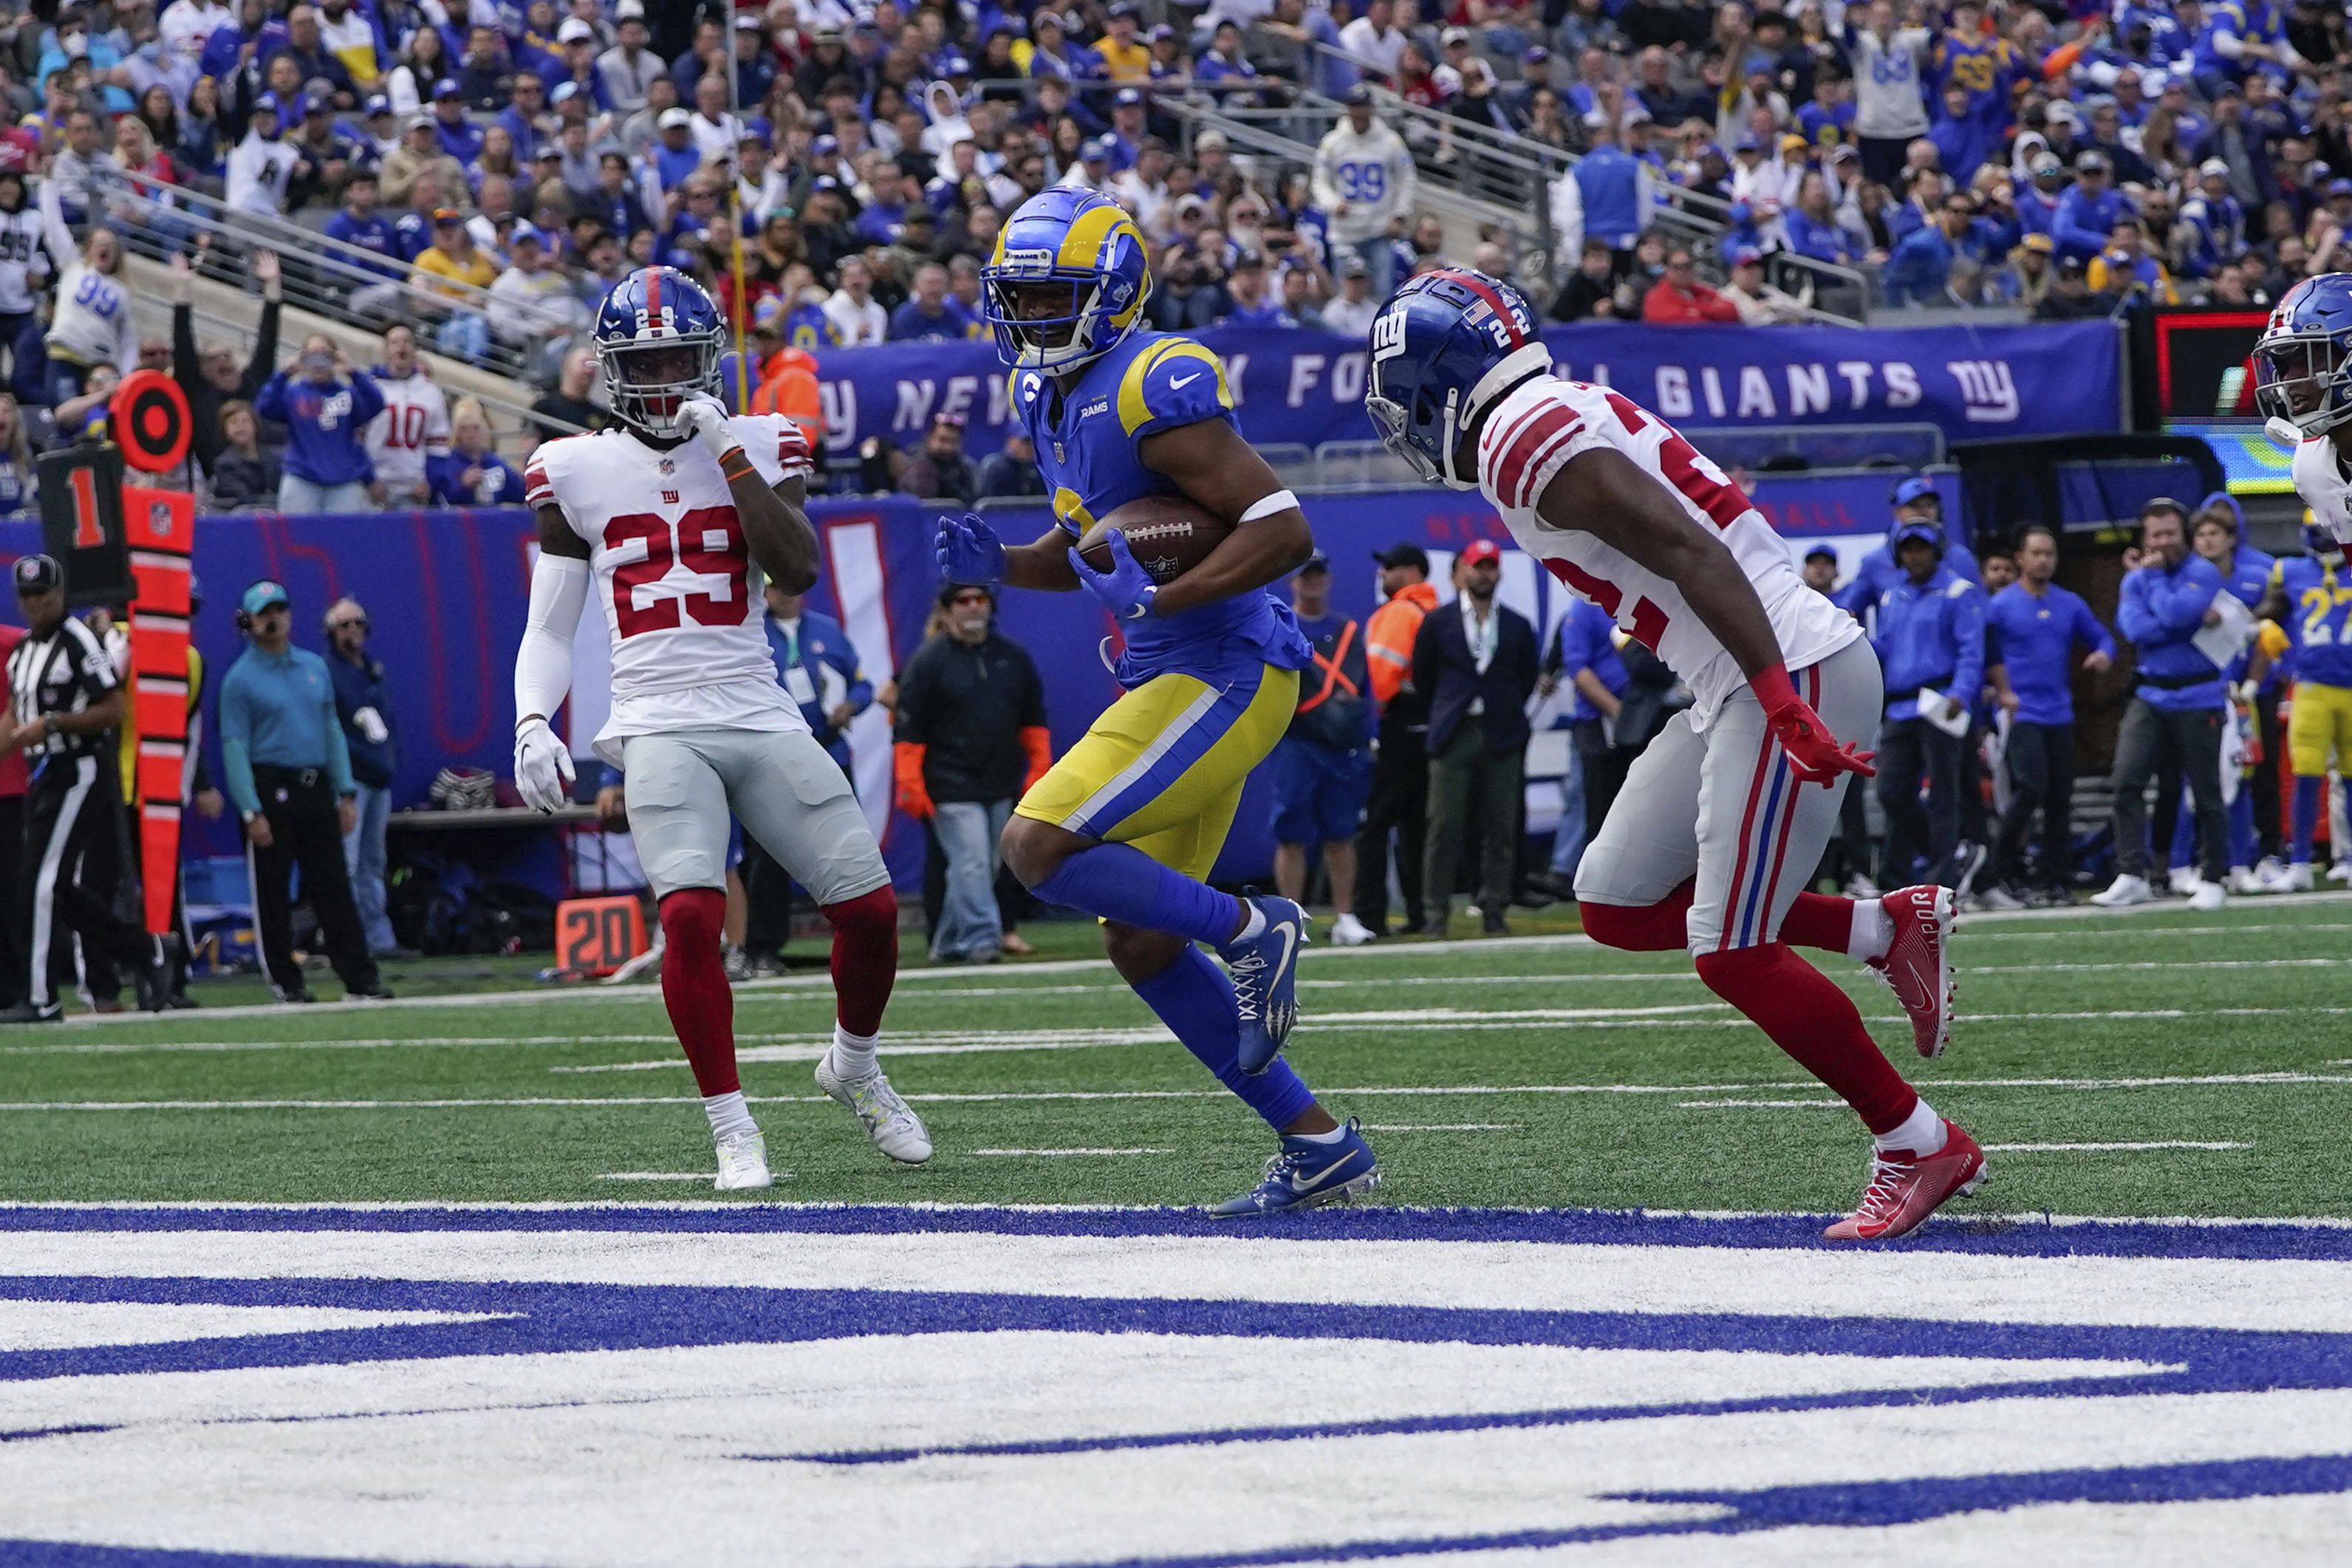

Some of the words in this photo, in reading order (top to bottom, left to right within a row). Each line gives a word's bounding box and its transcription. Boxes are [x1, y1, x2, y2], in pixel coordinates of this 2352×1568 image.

[75, 273, 119, 318] 99
[635, 306, 674, 329] 29
[1488, 308, 1531, 349] 22
[1022, 372, 1042, 403] C
[1081, 401, 1108, 418] RAMS
[1655, 360, 1923, 418] GIANTS
[385, 404, 426, 449] 10
[66, 466, 106, 548] 1
[603, 504, 749, 640] 29
[2300, 586, 2352, 648] 27
[567, 906, 631, 972] 20
